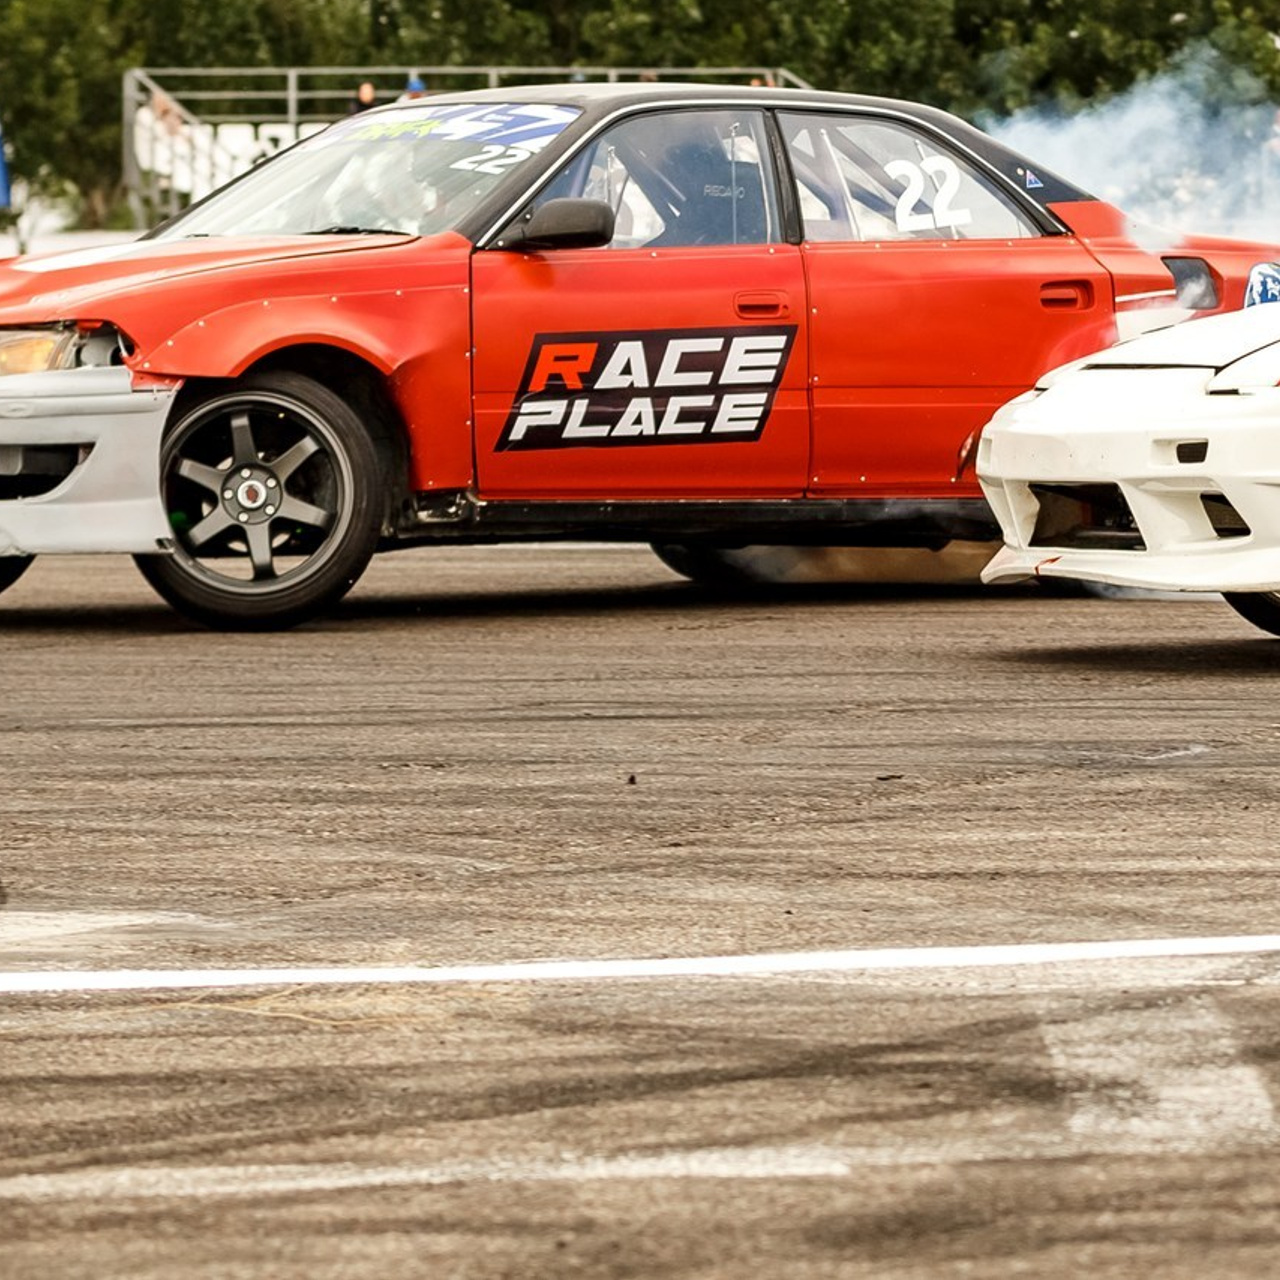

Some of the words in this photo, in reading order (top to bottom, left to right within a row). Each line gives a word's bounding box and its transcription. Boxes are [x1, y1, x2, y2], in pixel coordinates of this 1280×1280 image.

[450, 145, 532, 175] 22
[704, 184, 746, 199] RECAO
[884, 155, 973, 232] 22
[528, 335, 788, 392] RACE
[508, 392, 768, 441] PLACE
